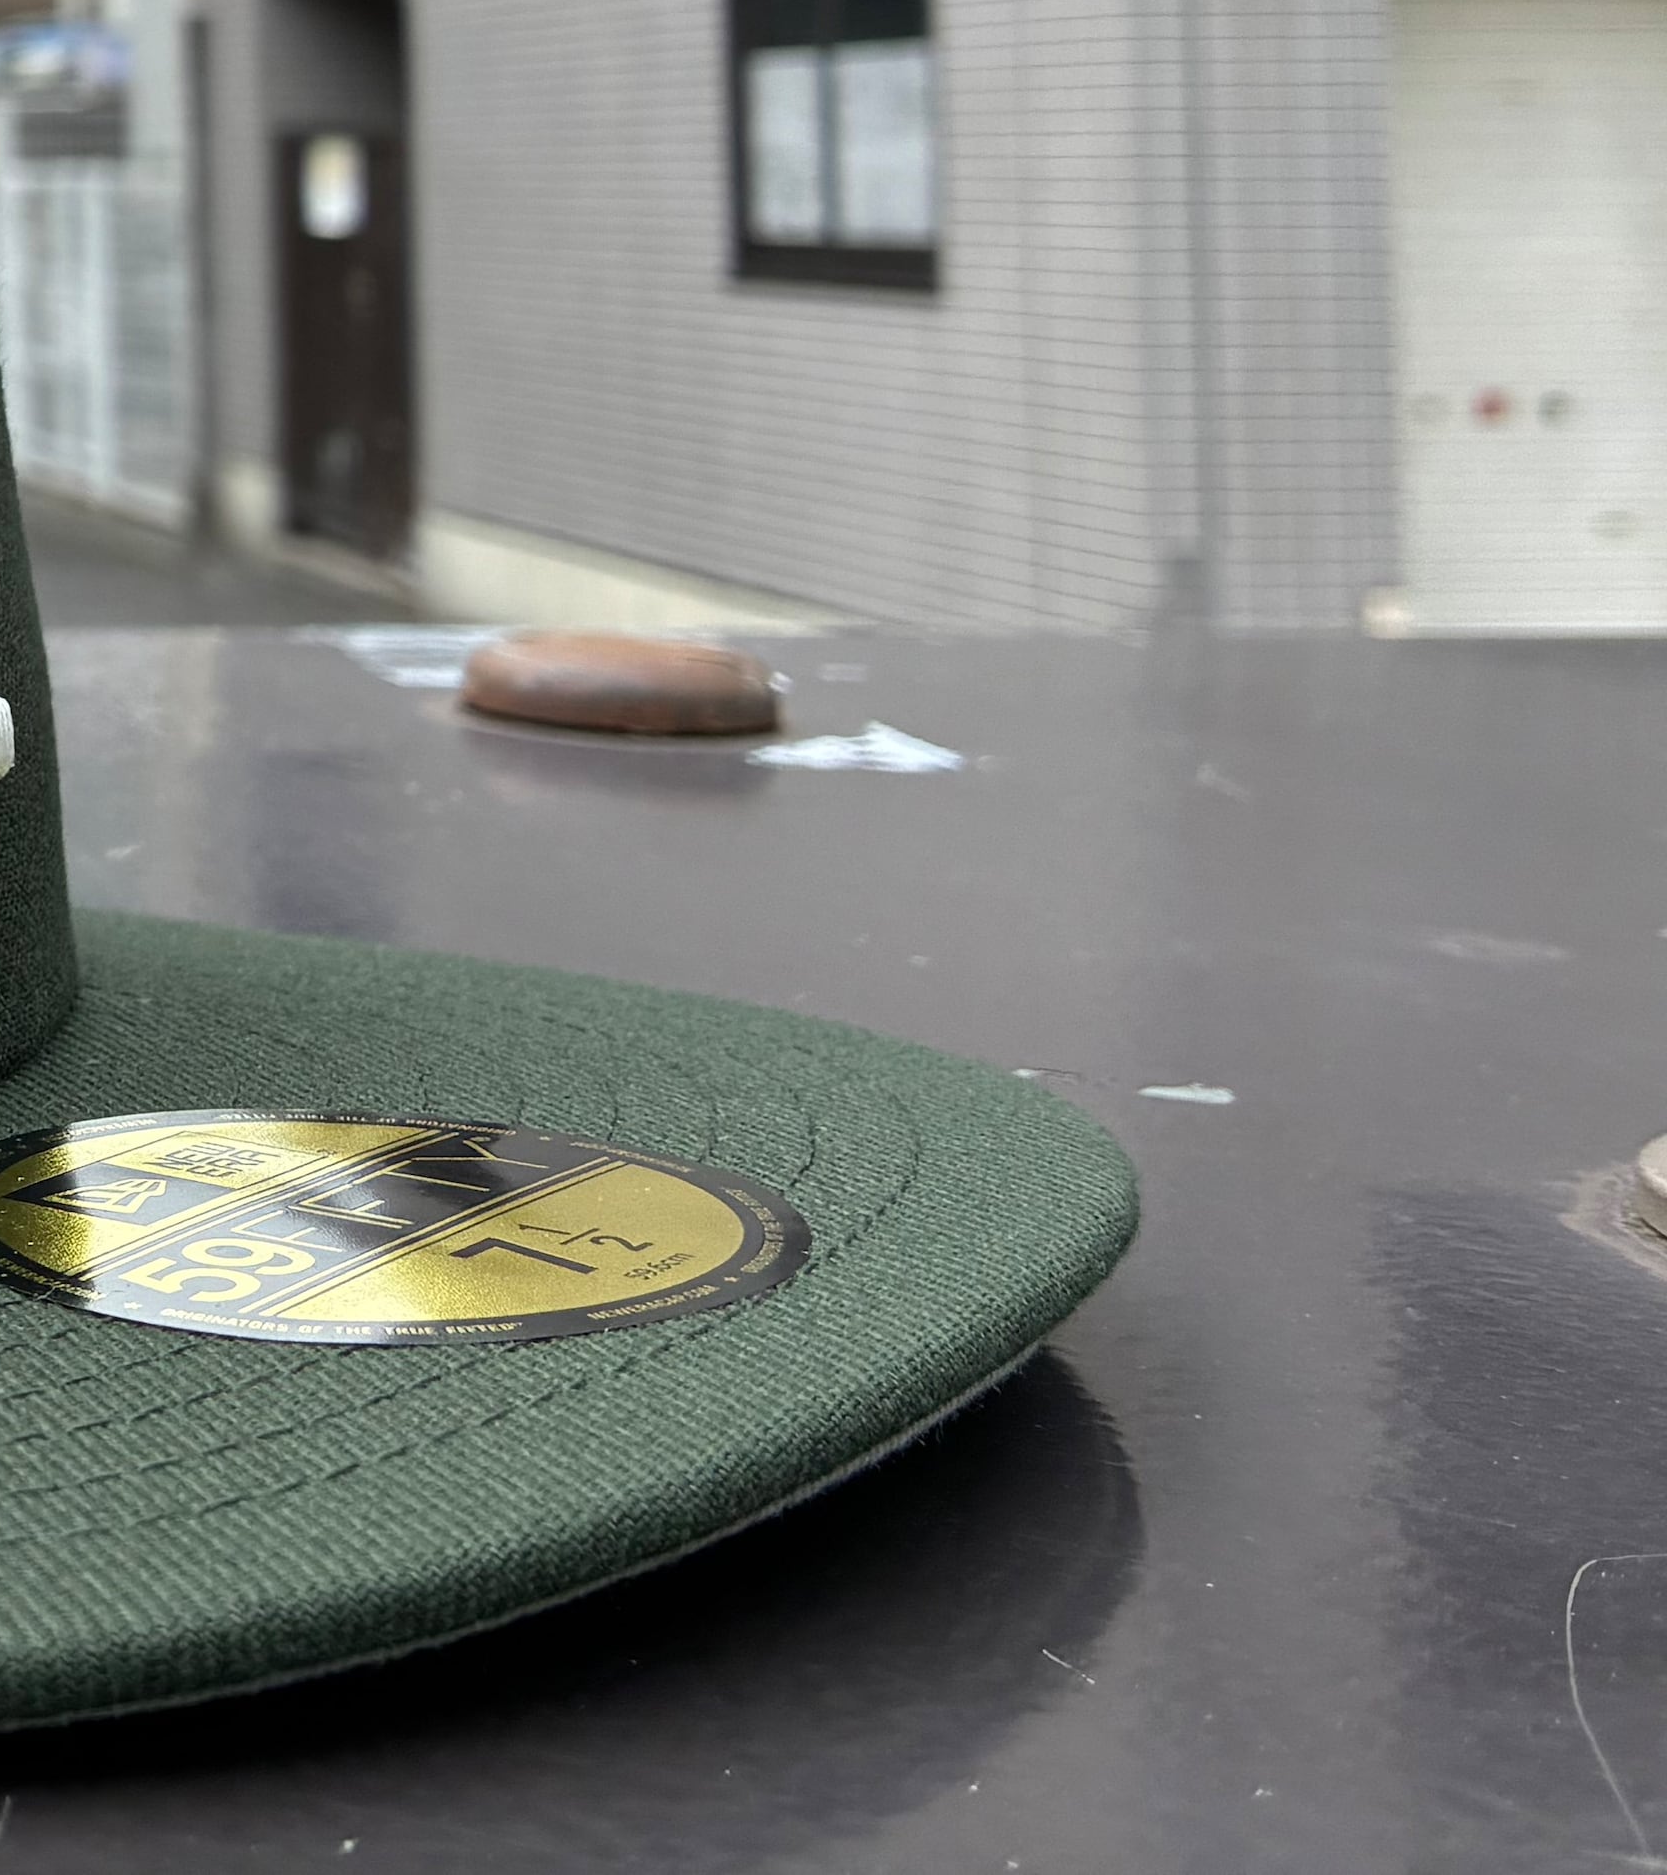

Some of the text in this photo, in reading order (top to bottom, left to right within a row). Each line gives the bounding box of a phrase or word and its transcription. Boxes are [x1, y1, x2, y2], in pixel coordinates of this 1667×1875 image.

[142, 1141, 236, 1171] NEW
[186, 1149, 281, 1178] ERA
[159, 1307, 290, 1333] ORIGINATORS
[298, 1324, 324, 1334] OF
[335, 1325, 372, 1335] THE
